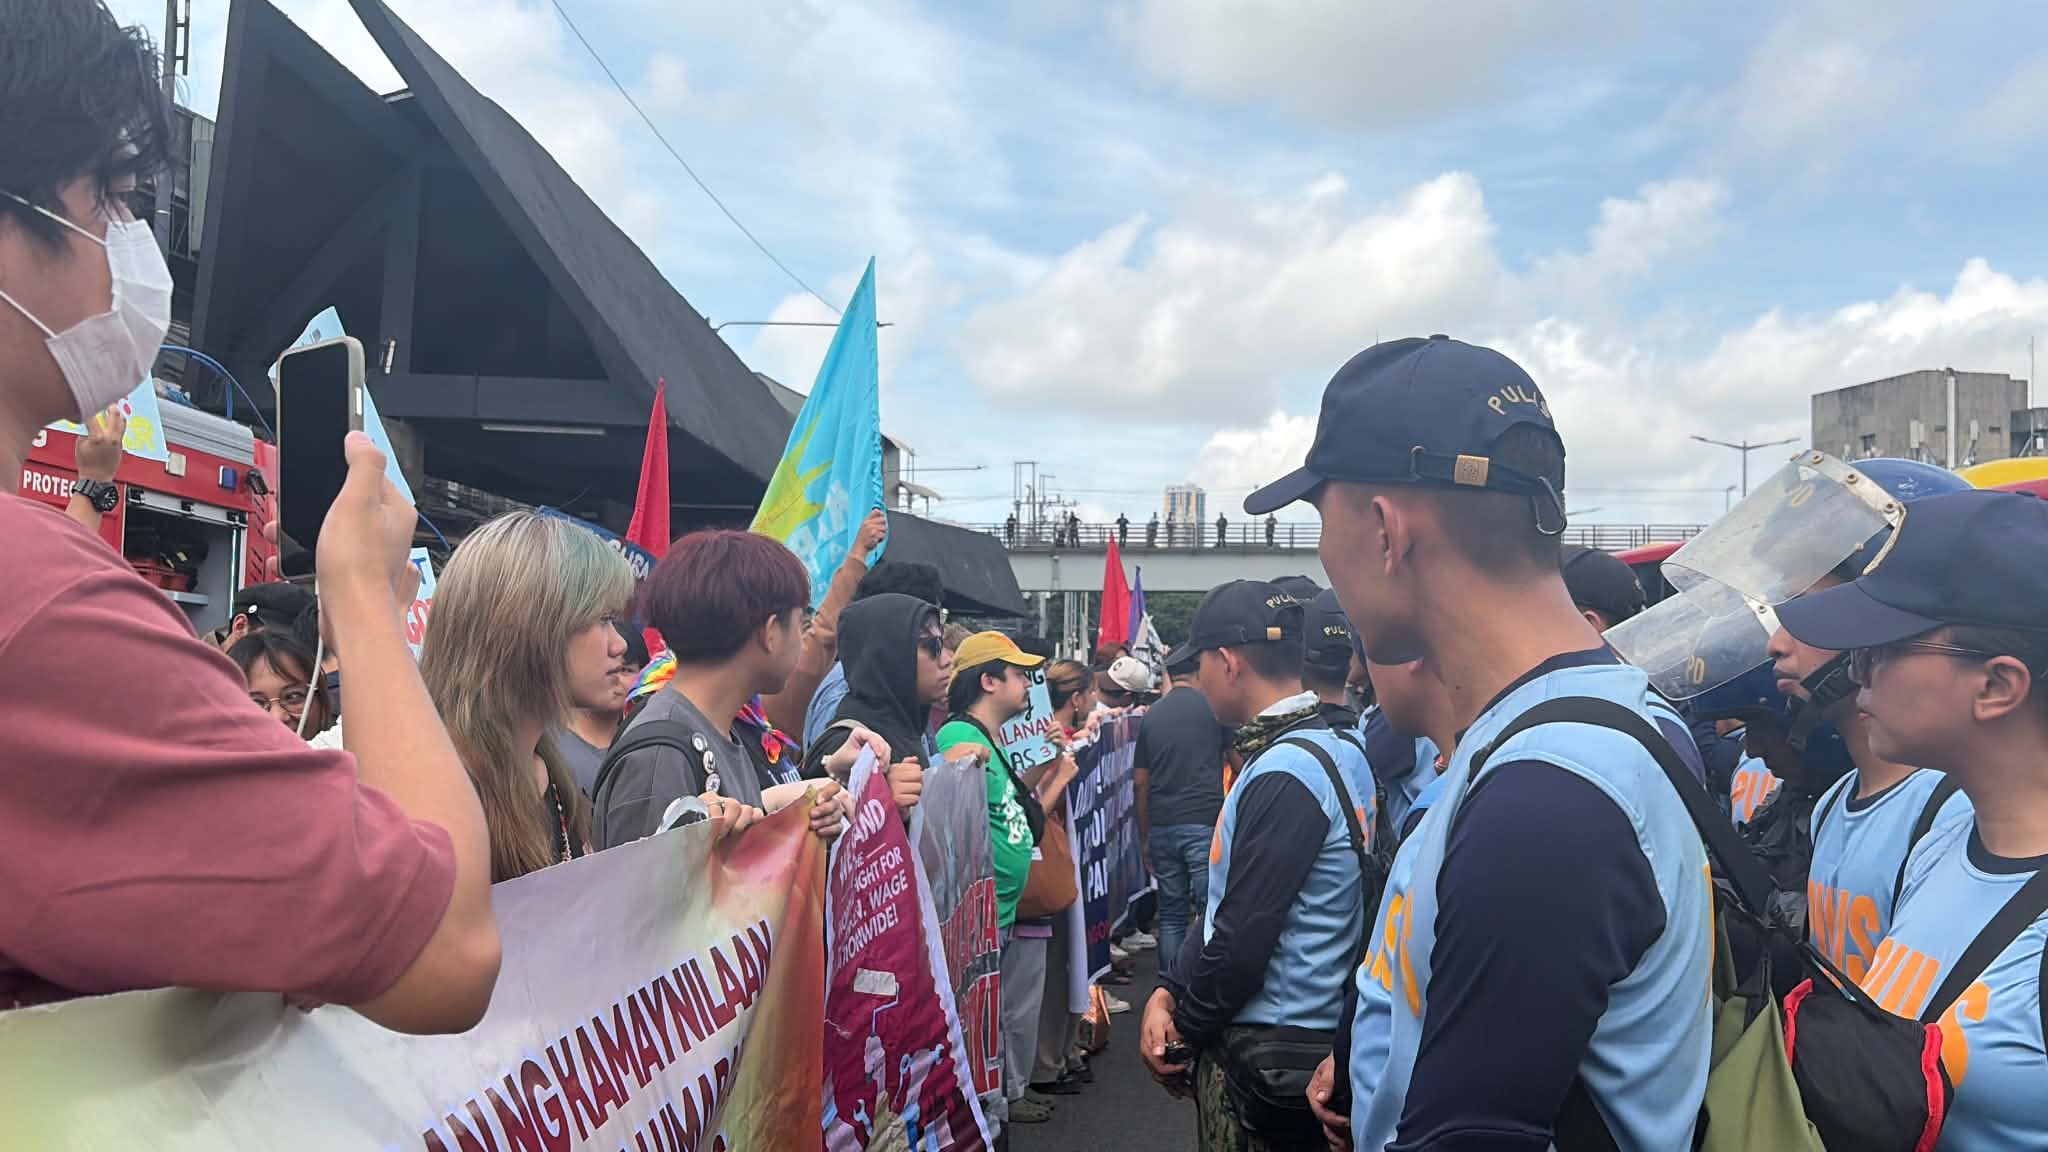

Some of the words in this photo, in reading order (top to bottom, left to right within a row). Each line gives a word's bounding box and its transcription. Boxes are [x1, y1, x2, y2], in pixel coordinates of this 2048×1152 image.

[851, 798, 887, 849] AND
[853, 859, 879, 893] IGHT
[879, 846, 904, 875] FOR
[868, 868, 909, 911] WAGE
